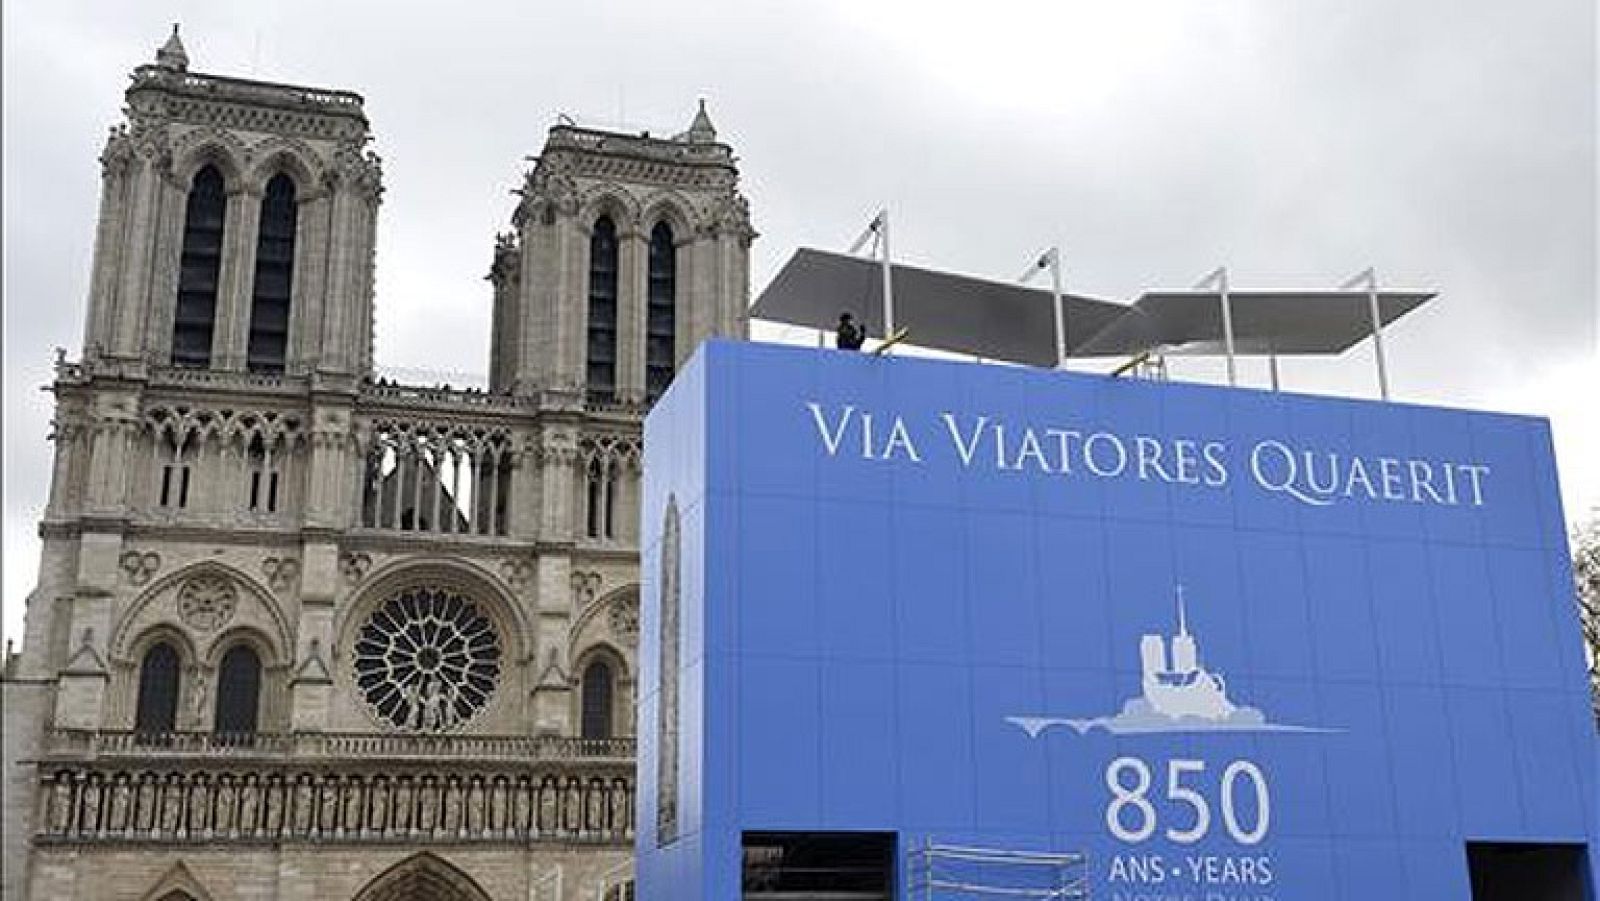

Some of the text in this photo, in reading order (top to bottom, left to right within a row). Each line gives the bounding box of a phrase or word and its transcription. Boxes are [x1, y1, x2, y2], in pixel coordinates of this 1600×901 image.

[807, 403, 1491, 506] VIA VIATORES QUAERIT
[1105, 757, 1270, 844] 850
[1109, 856, 1273, 885] ANS YEARS
